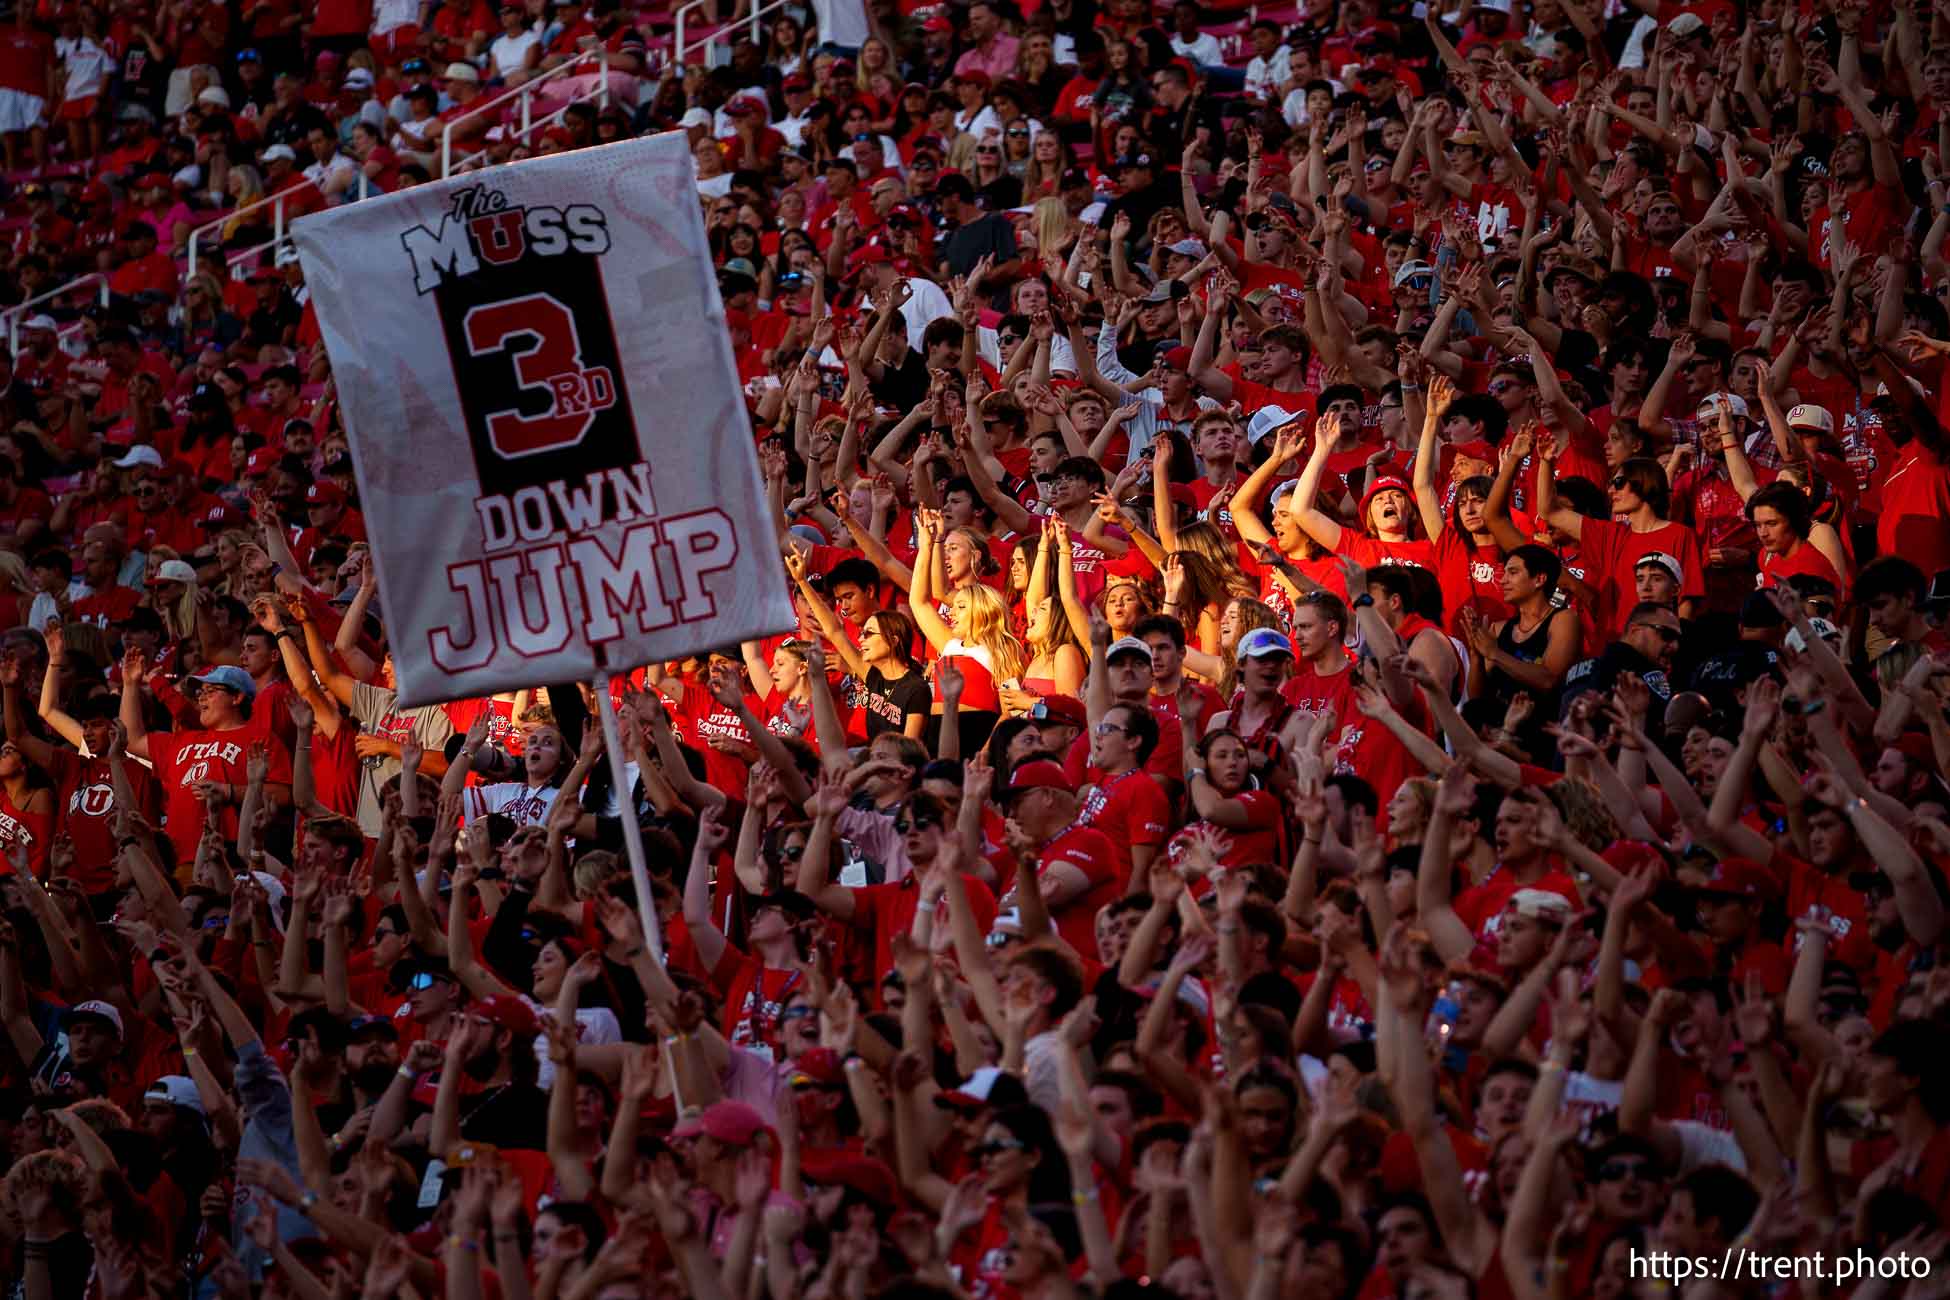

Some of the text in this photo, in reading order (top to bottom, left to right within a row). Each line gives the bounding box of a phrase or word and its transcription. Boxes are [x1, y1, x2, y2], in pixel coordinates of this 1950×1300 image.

[450, 184, 508, 222] The
[401, 204, 612, 297] MUSS
[474, 460, 657, 553] DOWN
[1196, 508, 1233, 522] MSS
[428, 506, 739, 676] JUMP
[697, 717, 752, 743] FOOTBALL
[708, 713, 742, 727] UTAH
[175, 741, 242, 772] UTAH
[0, 811, 33, 846] TAH
